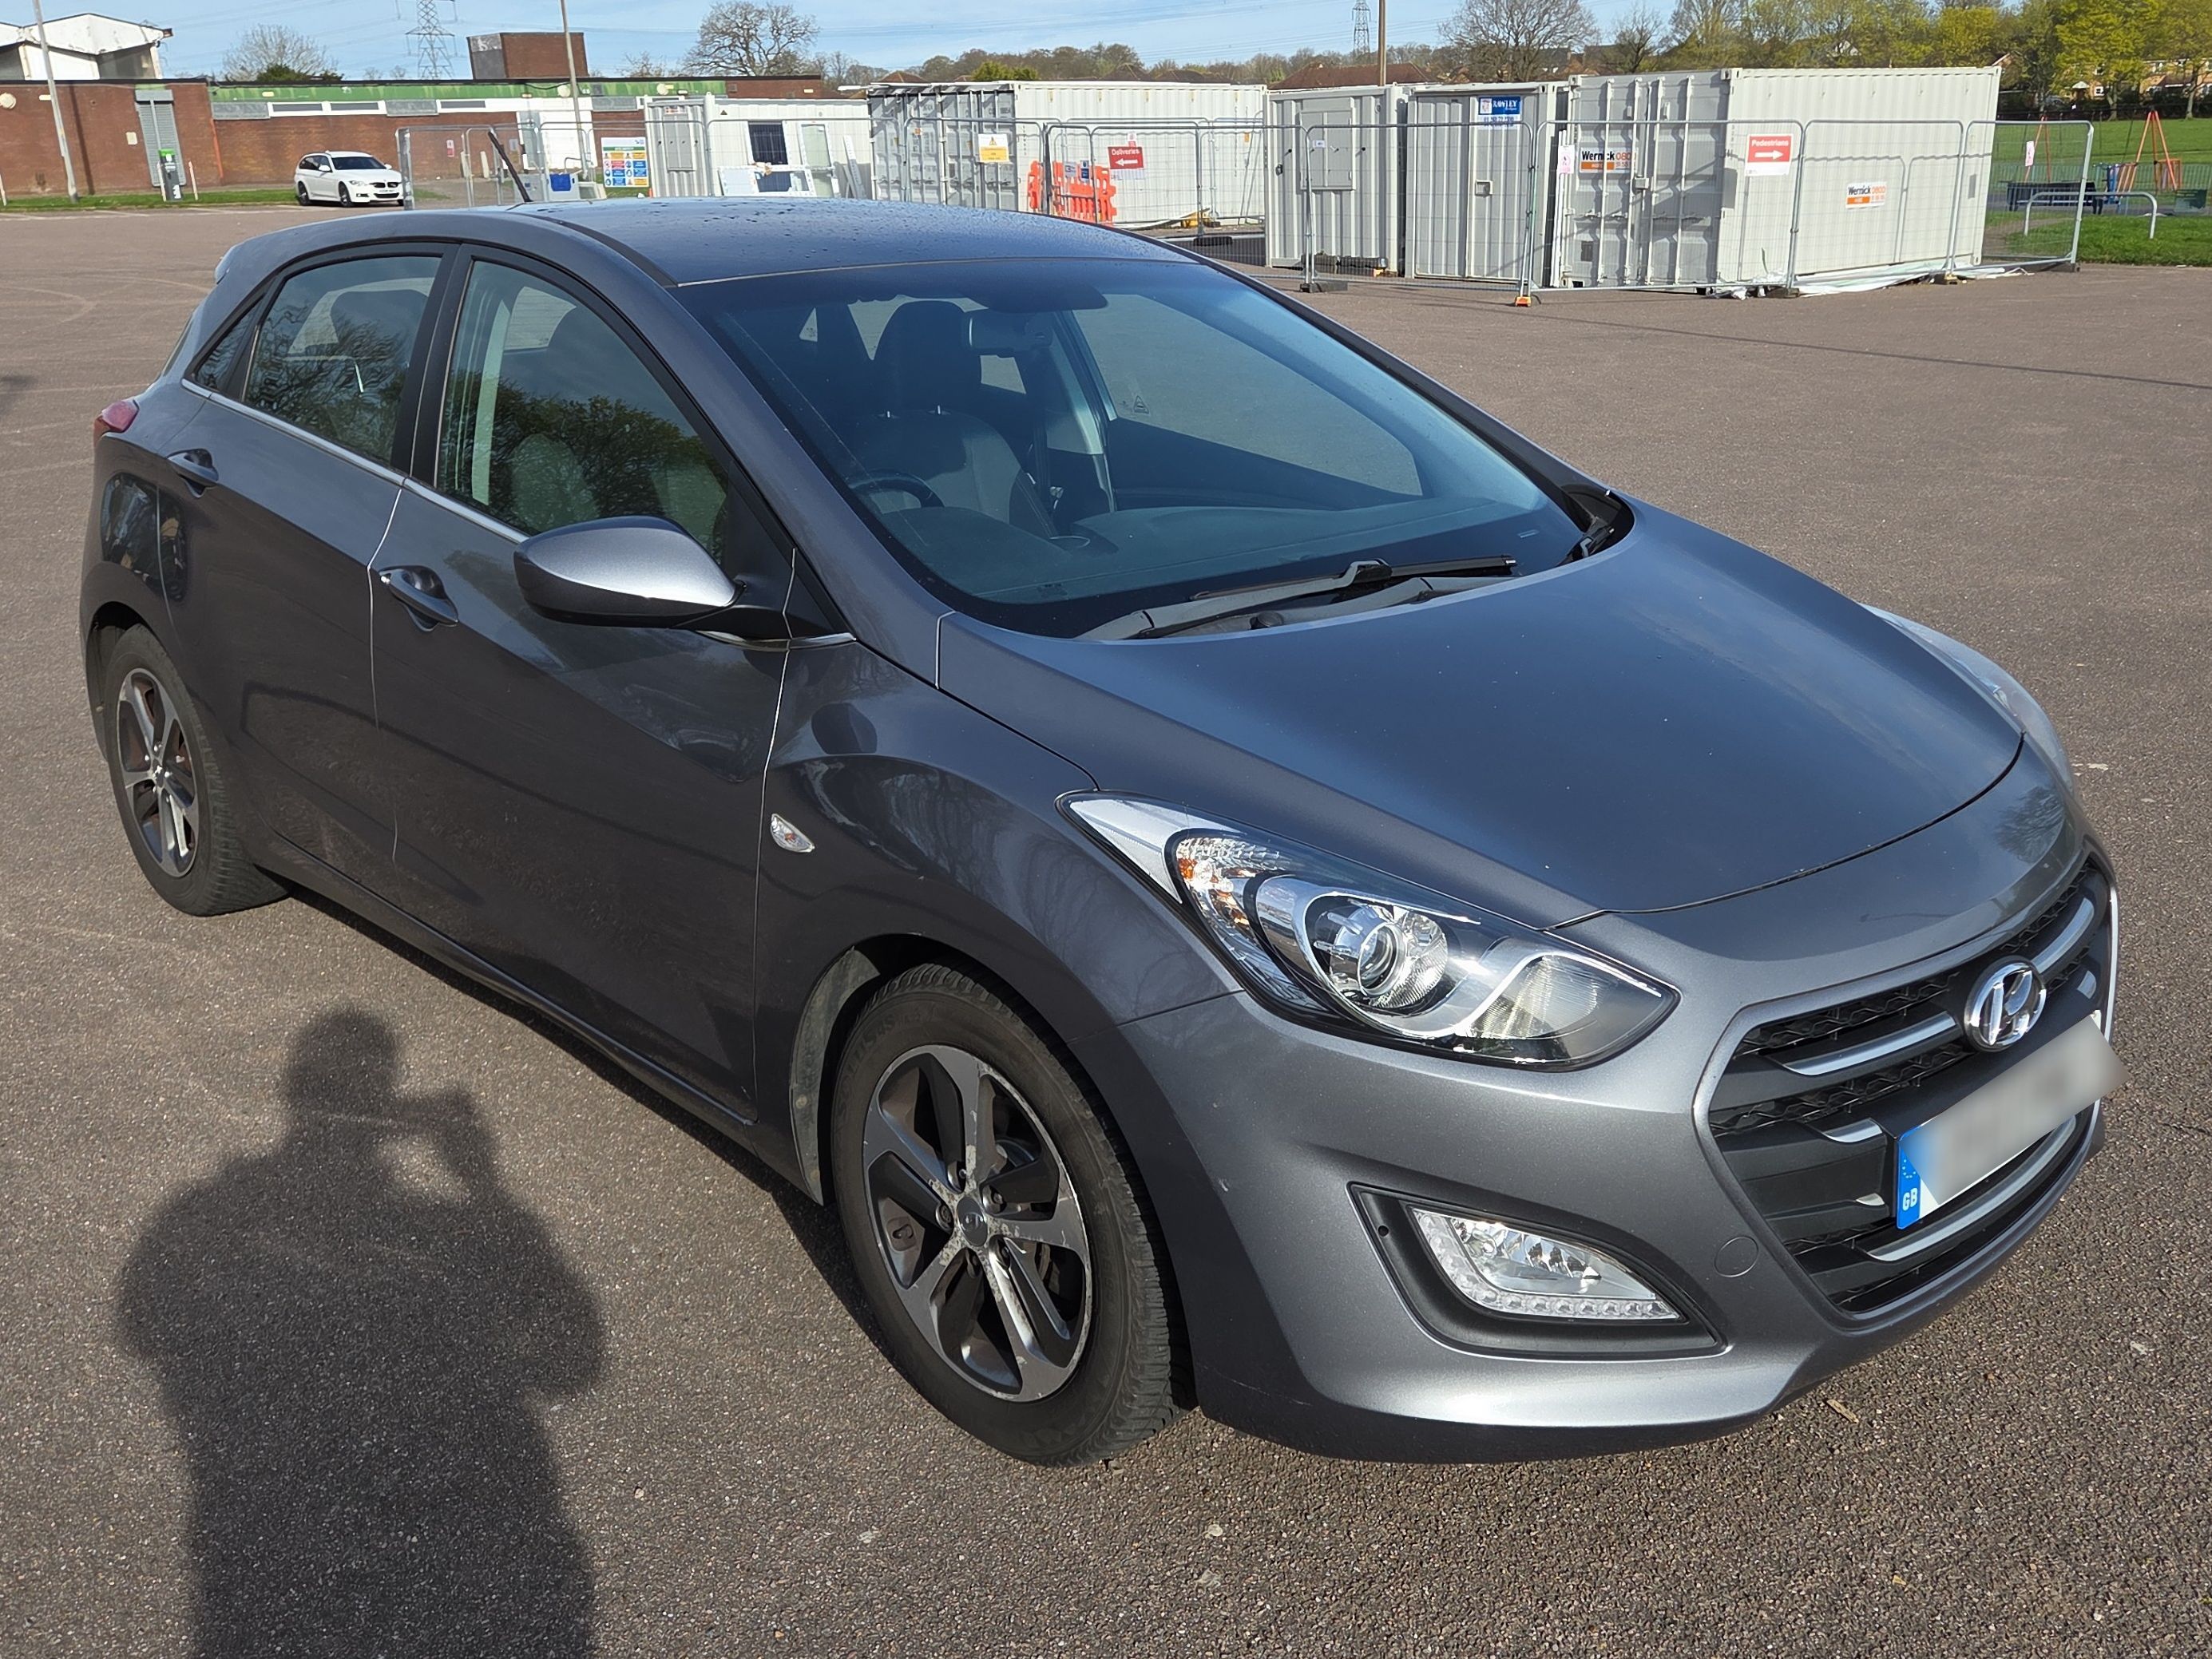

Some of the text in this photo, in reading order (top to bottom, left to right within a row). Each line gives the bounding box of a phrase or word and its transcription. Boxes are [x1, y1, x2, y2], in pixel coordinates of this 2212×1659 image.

[1582, 151, 1636, 160] Wernk 080
[1903, 1187, 1917, 1211] GB
